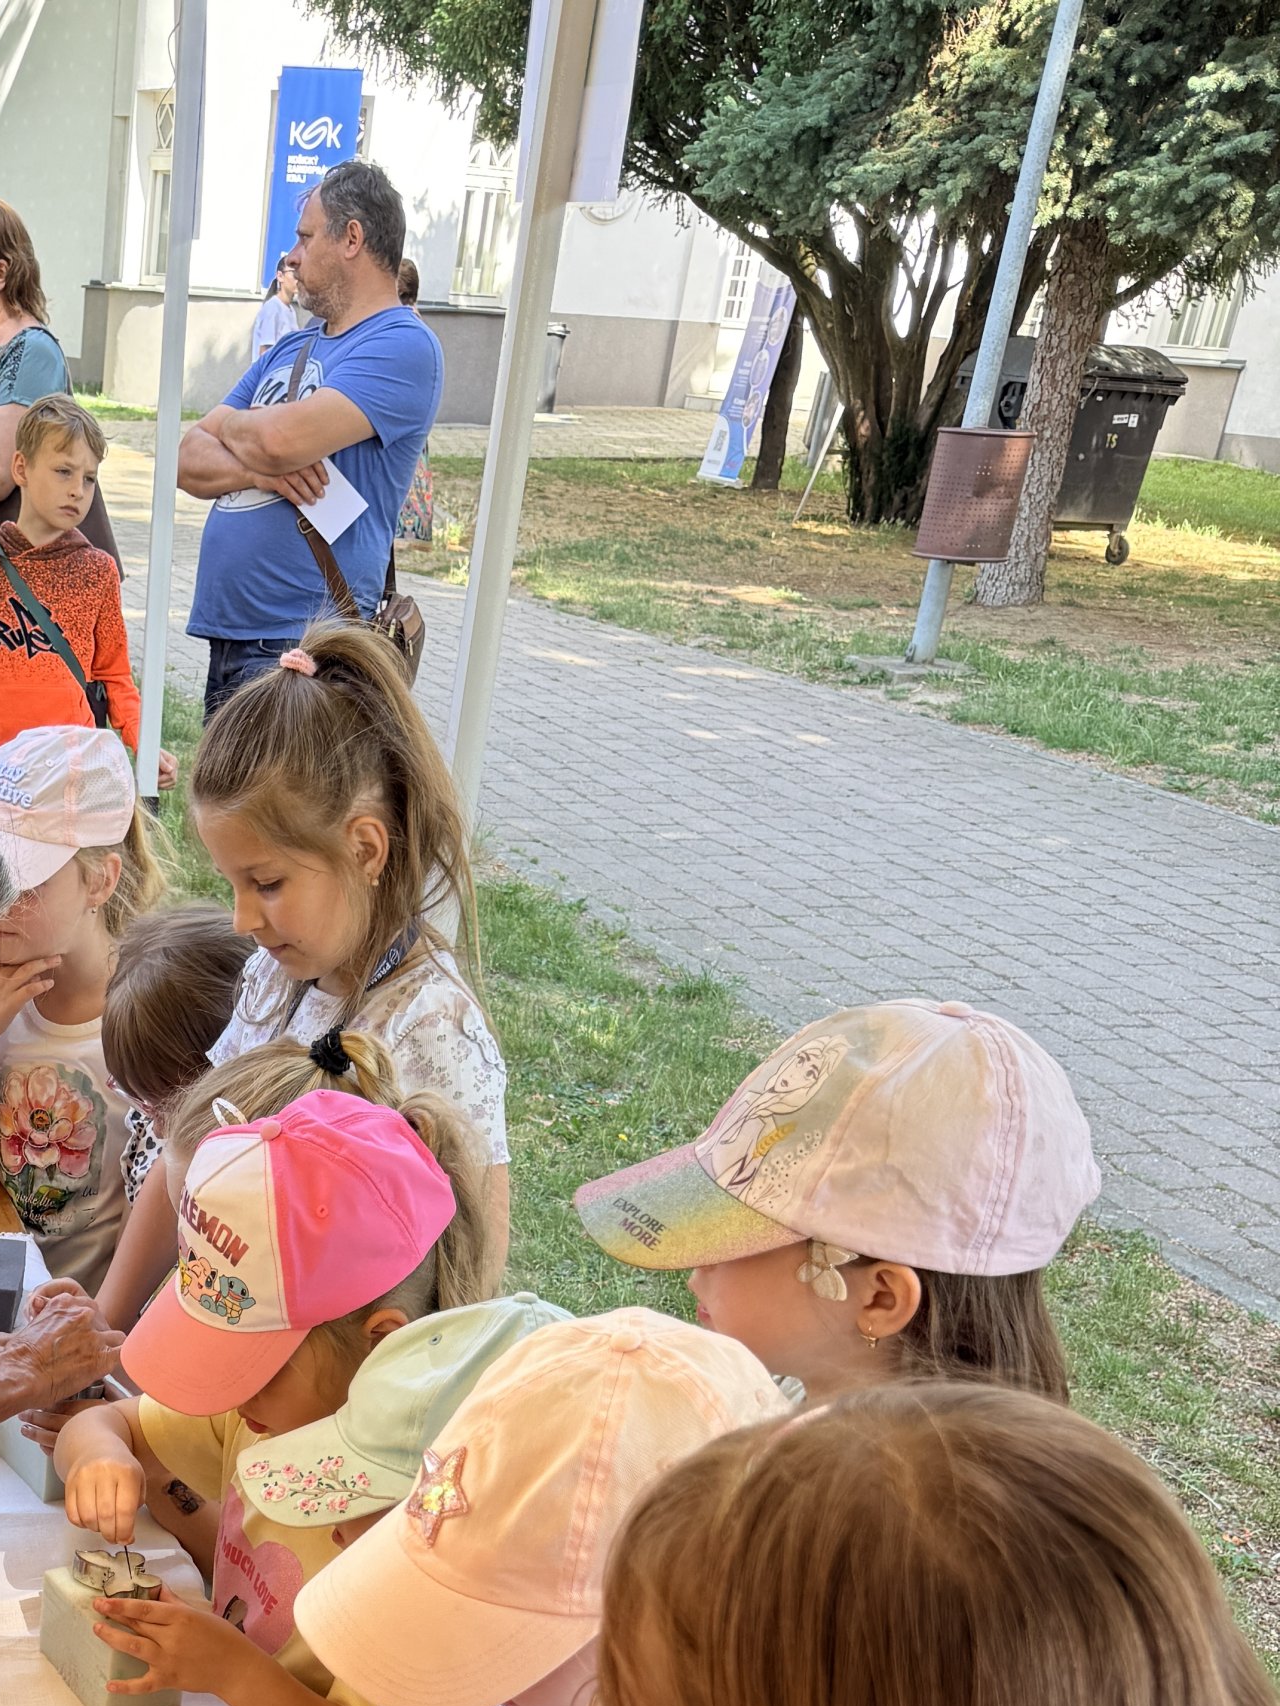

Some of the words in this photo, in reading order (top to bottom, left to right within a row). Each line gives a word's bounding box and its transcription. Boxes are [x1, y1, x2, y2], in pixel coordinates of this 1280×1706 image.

[289, 116, 343, 150] KSK
[613, 1197, 667, 1236] EXPLORE
[618, 1217, 661, 1251] MORE
[222, 1536, 255, 1581] MUCH
[253, 1573, 278, 1616] LOVE
